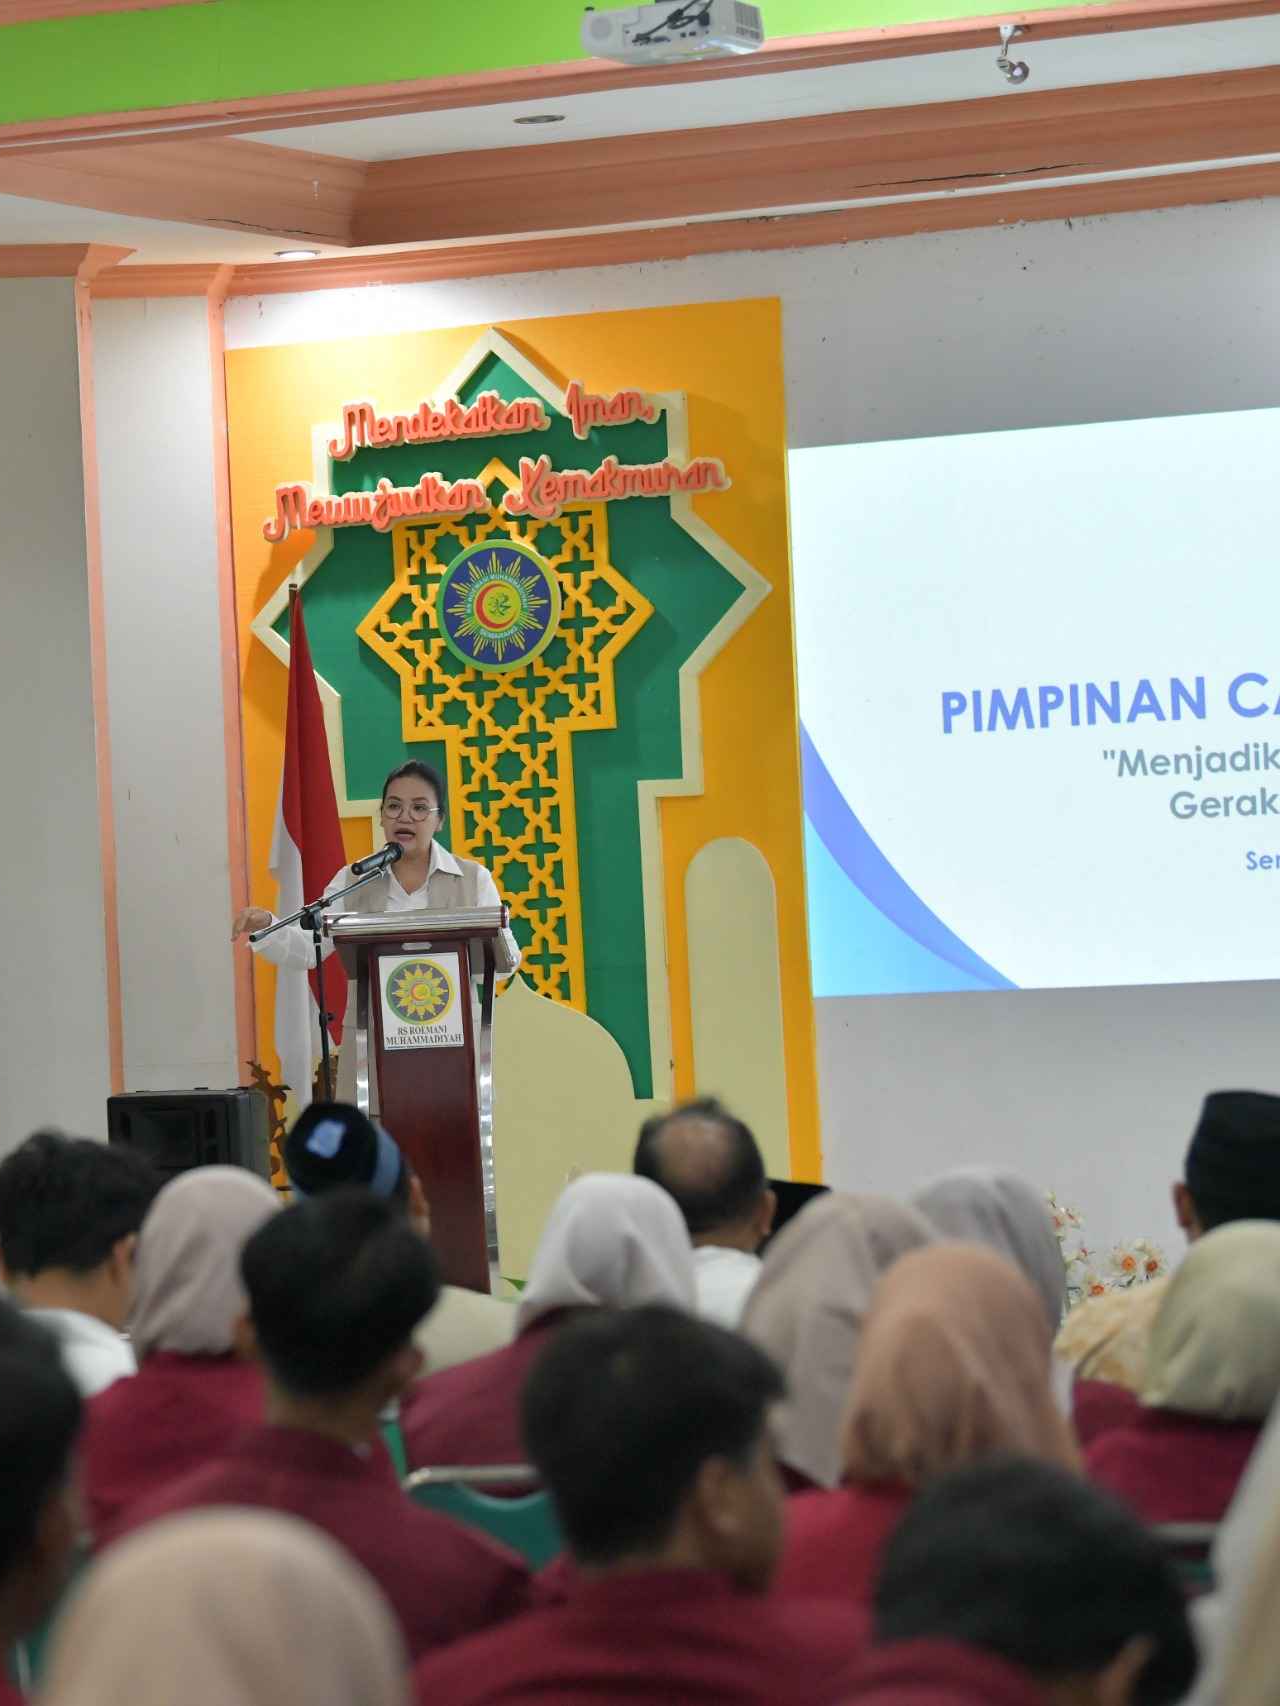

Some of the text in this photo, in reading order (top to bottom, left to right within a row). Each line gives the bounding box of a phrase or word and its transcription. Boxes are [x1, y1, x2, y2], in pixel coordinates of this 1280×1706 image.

[329, 391, 547, 460] Mendekatkan
[264, 456, 726, 538] Mewujudkan Kemakmuran
[941, 672, 1280, 734] PIMPINAN C
[1170, 787, 1280, 820] Gerak
[385, 1033, 461, 1046] MUHAMMADIYAH
